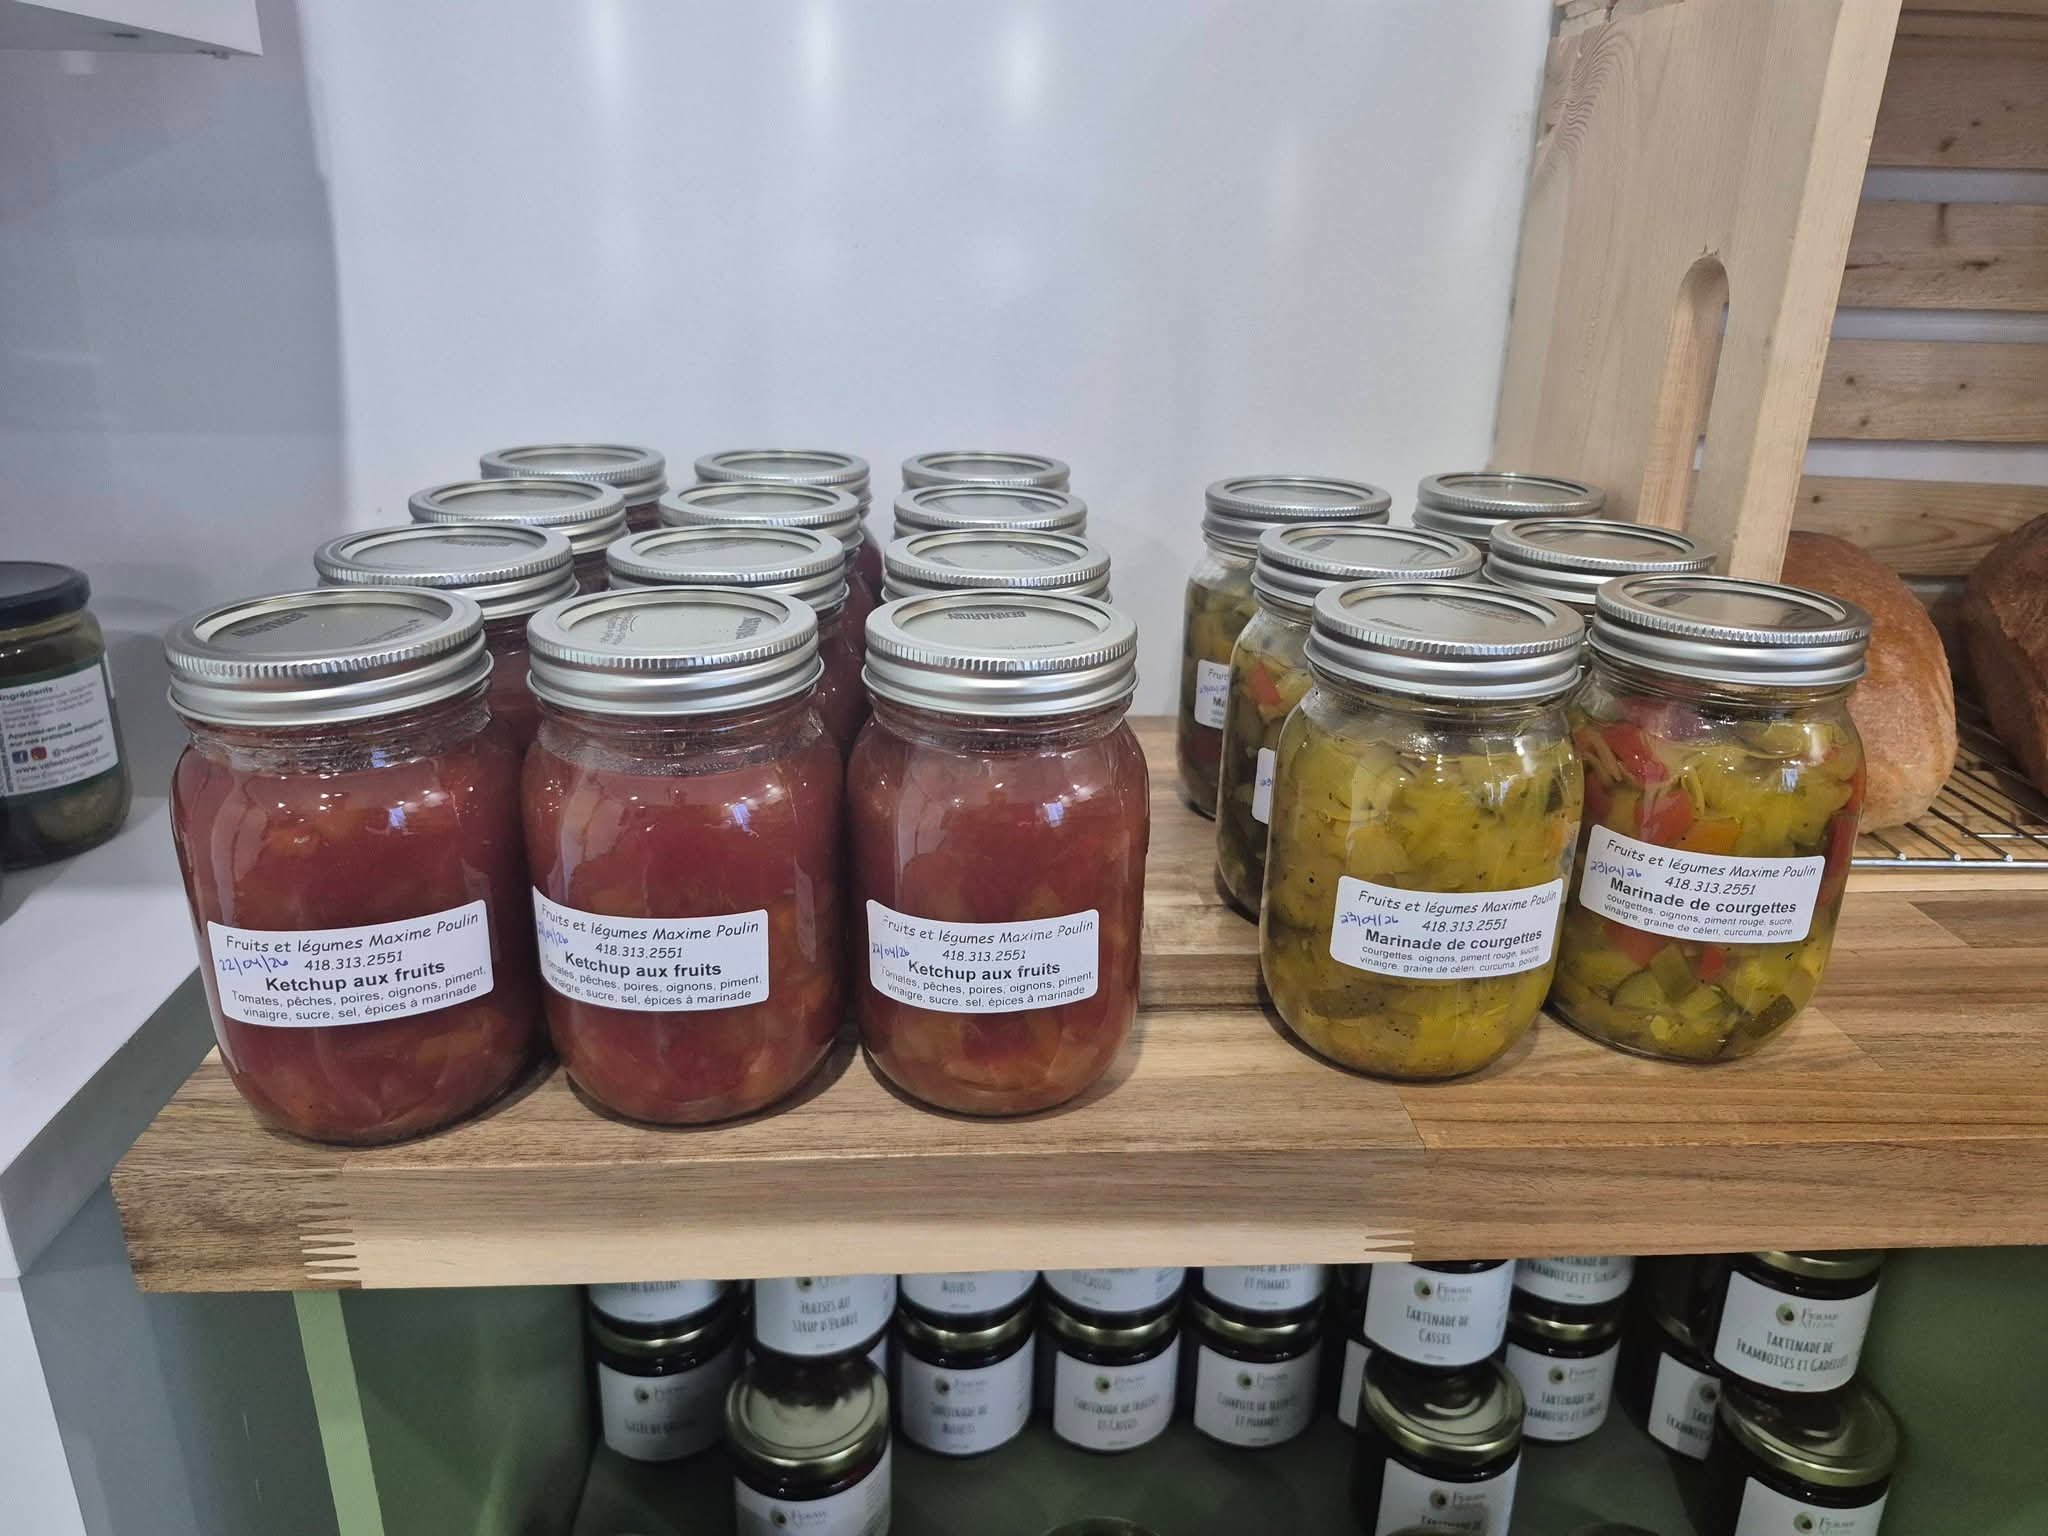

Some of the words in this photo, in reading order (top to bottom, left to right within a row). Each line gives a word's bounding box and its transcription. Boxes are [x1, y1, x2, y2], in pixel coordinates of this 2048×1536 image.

[1208, 668, 1230, 681] Fruit
[1606, 839, 1646, 863] Fruits
[1648, 855, 1664, 867] et
[1668, 857, 1726, 877] légumes
[1728, 866, 1780, 878] Maxime
[1783, 866, 1817, 878] Poulin
[1610, 877, 1686, 908] Marinade
[1690, 898, 1711, 912] de
[1715, 902, 1797, 917] courgettes
[1664, 877, 1756, 896] 418.313.2551
[1358, 890, 1401, 910] Fruits
[1404, 900, 1421, 913] et
[1425, 901, 1478, 917] légumes
[1481, 898, 1527, 914] Maxime
[1529, 889, 1558, 908] Poulin
[541, 903, 569, 928] Fruits
[572, 921, 586, 933] et
[591, 922, 648, 942] légumes
[652, 927, 712, 941] Maxime
[716, 922, 759, 938] Poulin
[1421, 918, 1508, 934] 418.313.2551
[1643, 916, 1674, 931] graine
[1676, 922, 1690, 933] de
[1767, 927, 1793, 938] poivre
[1659, 909, 1701, 925] oignons,
[1704, 915, 1737, 928] piment
[226, 935, 269, 954] Fruits
[274, 940, 291, 953] et
[298, 937, 363, 956] légumes
[369, 925, 432, 947] Maxime
[437, 912, 479, 935] Poulin
[881, 915, 916, 937] Fruits
[919, 929, 935, 941] et
[938, 929, 995, 947] légumes
[999, 928, 1053, 944] Maxime
[1056, 920, 1094, 937] Poulin
[1365, 928, 1442, 950] Marinade
[1447, 938, 1466, 950] de
[1471, 929, 1543, 951] courgettes
[304, 950, 403, 971] 418.313.2551
[595, 942, 683, 959] 418.313.2551
[941, 949, 1027, 963] 418.313.2551
[1418, 950, 1457, 963] oignons,
[1460, 952, 1491, 964] piment
[565, 951, 630, 978] Ketchup
[636, 966, 668, 978] aux
[674, 963, 722, 978] fruits
[908, 959, 977, 983] Ketchup
[981, 967, 1012, 980] aux
[1017, 962, 1062, 978] fruits
[1403, 963, 1433, 974] graine
[1435, 963, 1449, 973] de
[1518, 956, 1540, 968] poivre
[232, 990, 283, 1008] Tomates,
[286, 993, 337, 1008] pêches,
[340, 990, 384, 1006] poires,
[388, 980, 442, 1001] oignons,
[445, 966, 487, 988] piment,
[265, 976, 347, 993] Ketchup
[353, 971, 389, 987] aux
[395, 962, 446, 982] fruits
[579, 974, 620, 990] pêches,
[623, 982, 662, 993] poires,
[666, 981, 716, 994] oignons,
[720, 975, 763, 990] piment,
[922, 981, 965, 995] pêches,
[968, 983, 1006, 996] poires,
[1009, 978, 1056, 995] oignons,
[1057, 970, 1095, 988] piment,
[243, 1007, 292, 1021] vinaigre,
[295, 1009, 334, 1021] sucre,
[338, 1006, 360, 1018] sel,
[364, 1000, 407, 1016] épices
[410, 999, 418, 1009] à
[422, 983, 477, 1006] marinade
[620, 993, 641, 1005] sel,
[644, 994, 683, 1007] épices
[685, 994, 694, 1004] à
[696, 989, 752, 1005] marinade
[965, 996, 984, 1008] sel,
[988, 996, 1024, 1010] épices
[1026, 993, 1035, 1003] à
[1037, 985, 1086, 1003] marinade
[1418, 1327, 1452, 1345] CASSIS
[1767, 1331, 1820, 1354] TARTINADE
[1821, 1341, 1834, 1354] DE
[1736, 1338, 1796, 1370] FRAMBOISES
